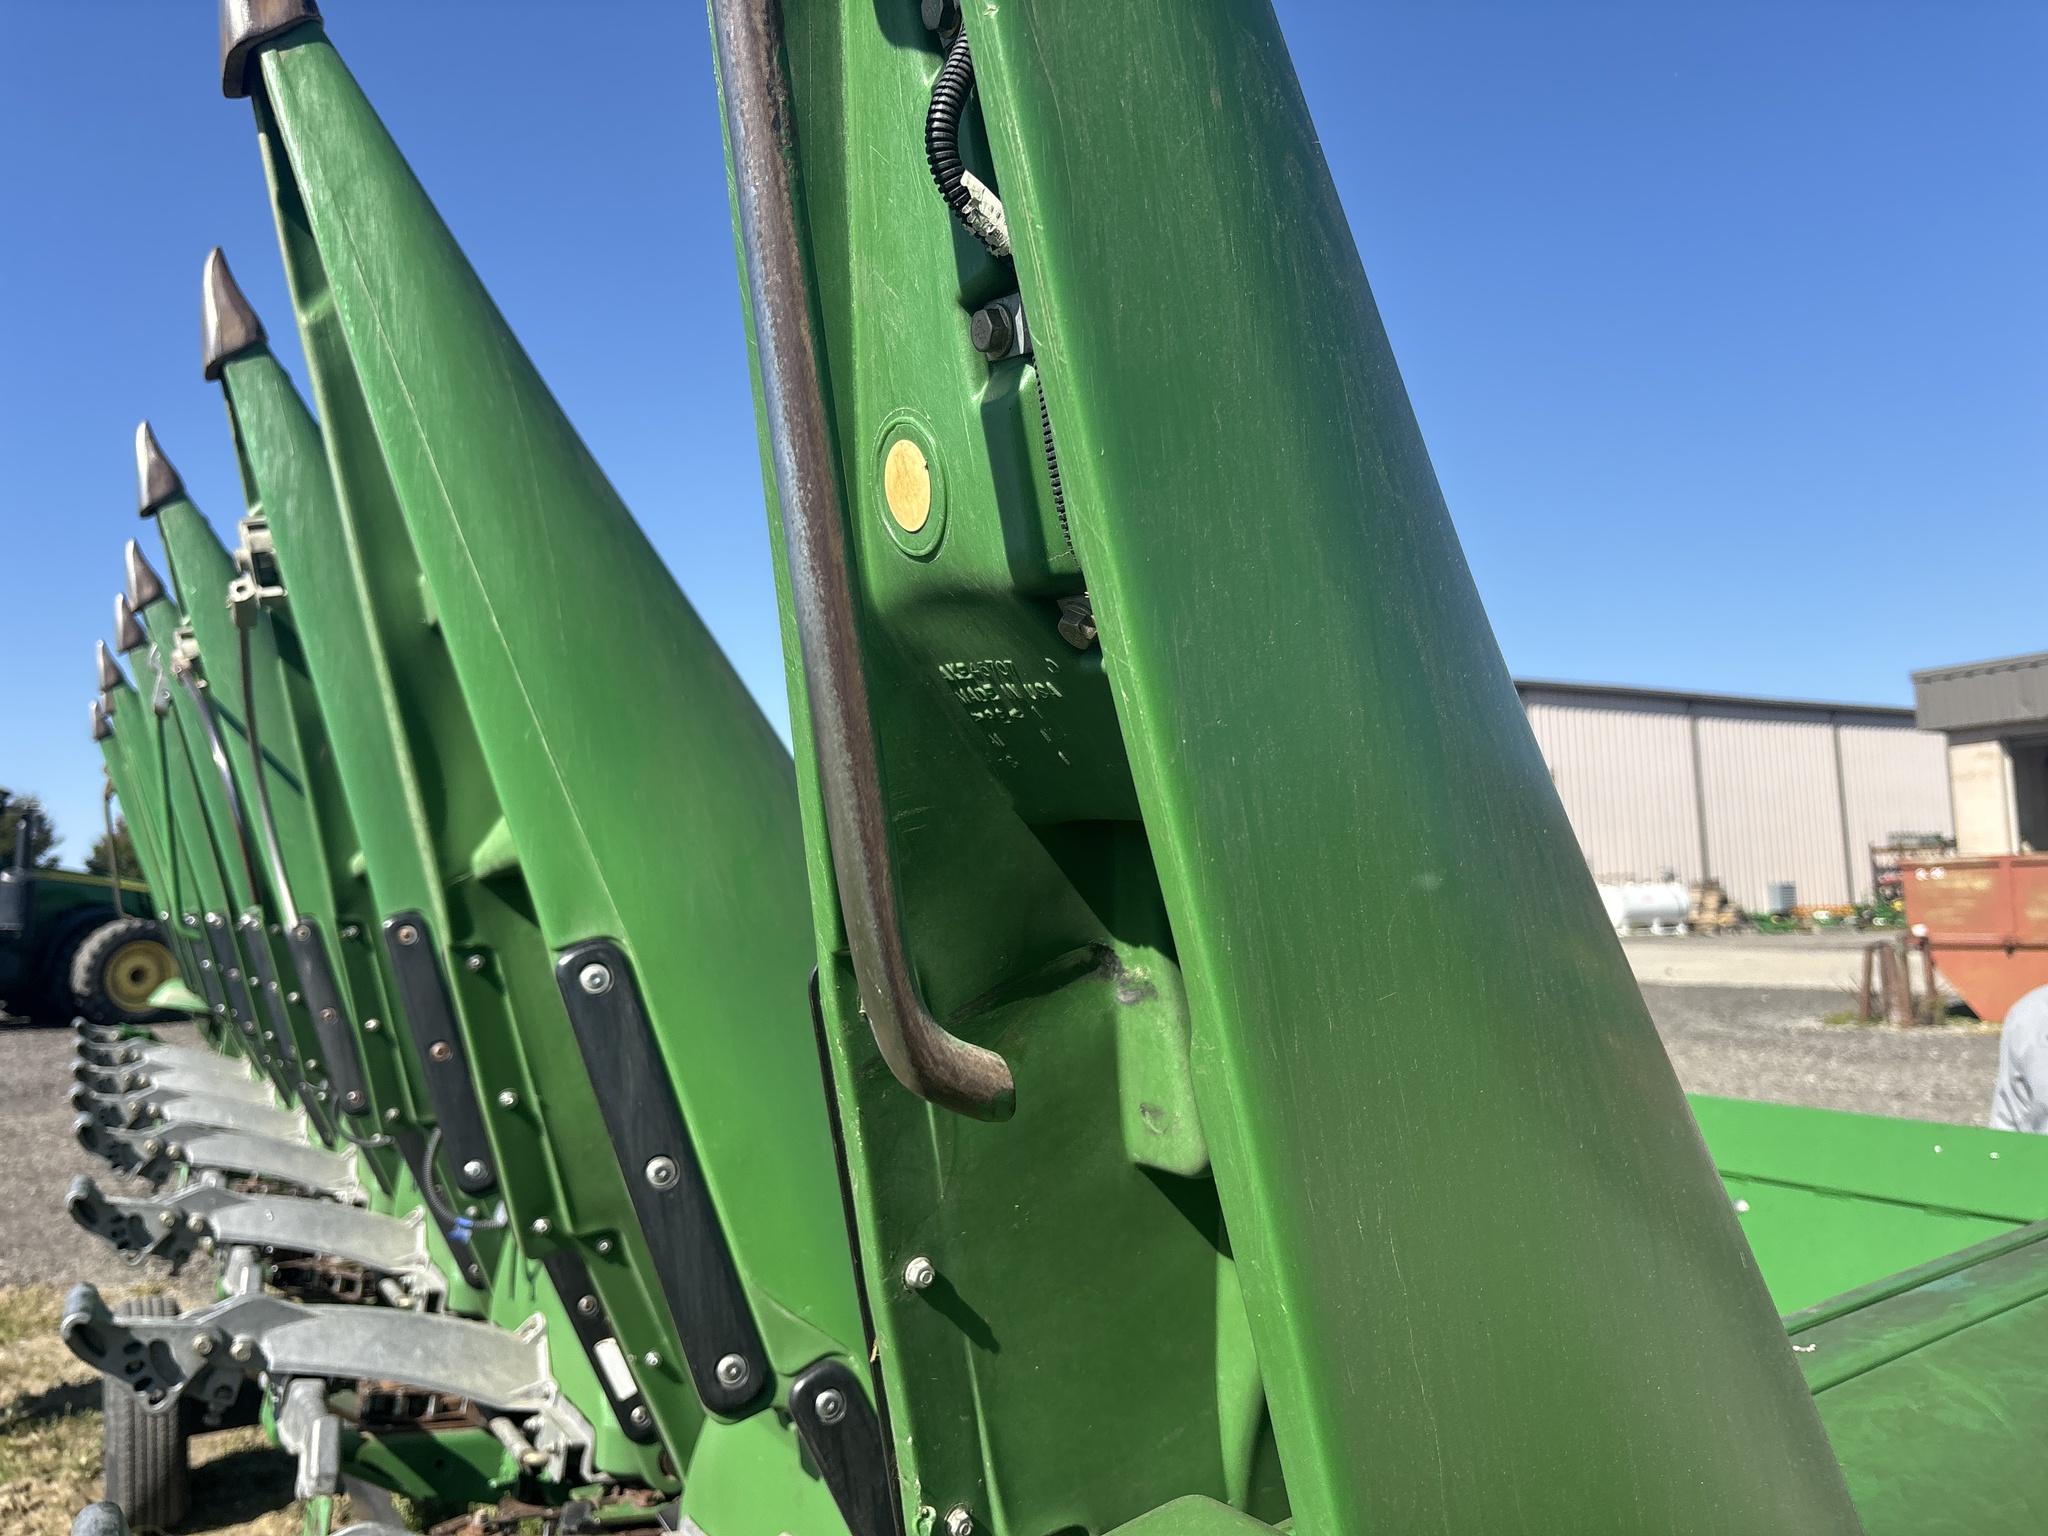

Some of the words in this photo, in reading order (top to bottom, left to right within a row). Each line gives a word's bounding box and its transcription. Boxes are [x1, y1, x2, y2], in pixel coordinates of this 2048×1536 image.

[955, 683, 1000, 703] MADE
[1000, 683, 1023, 699] IN
[1023, 682, 1063, 700] USA
